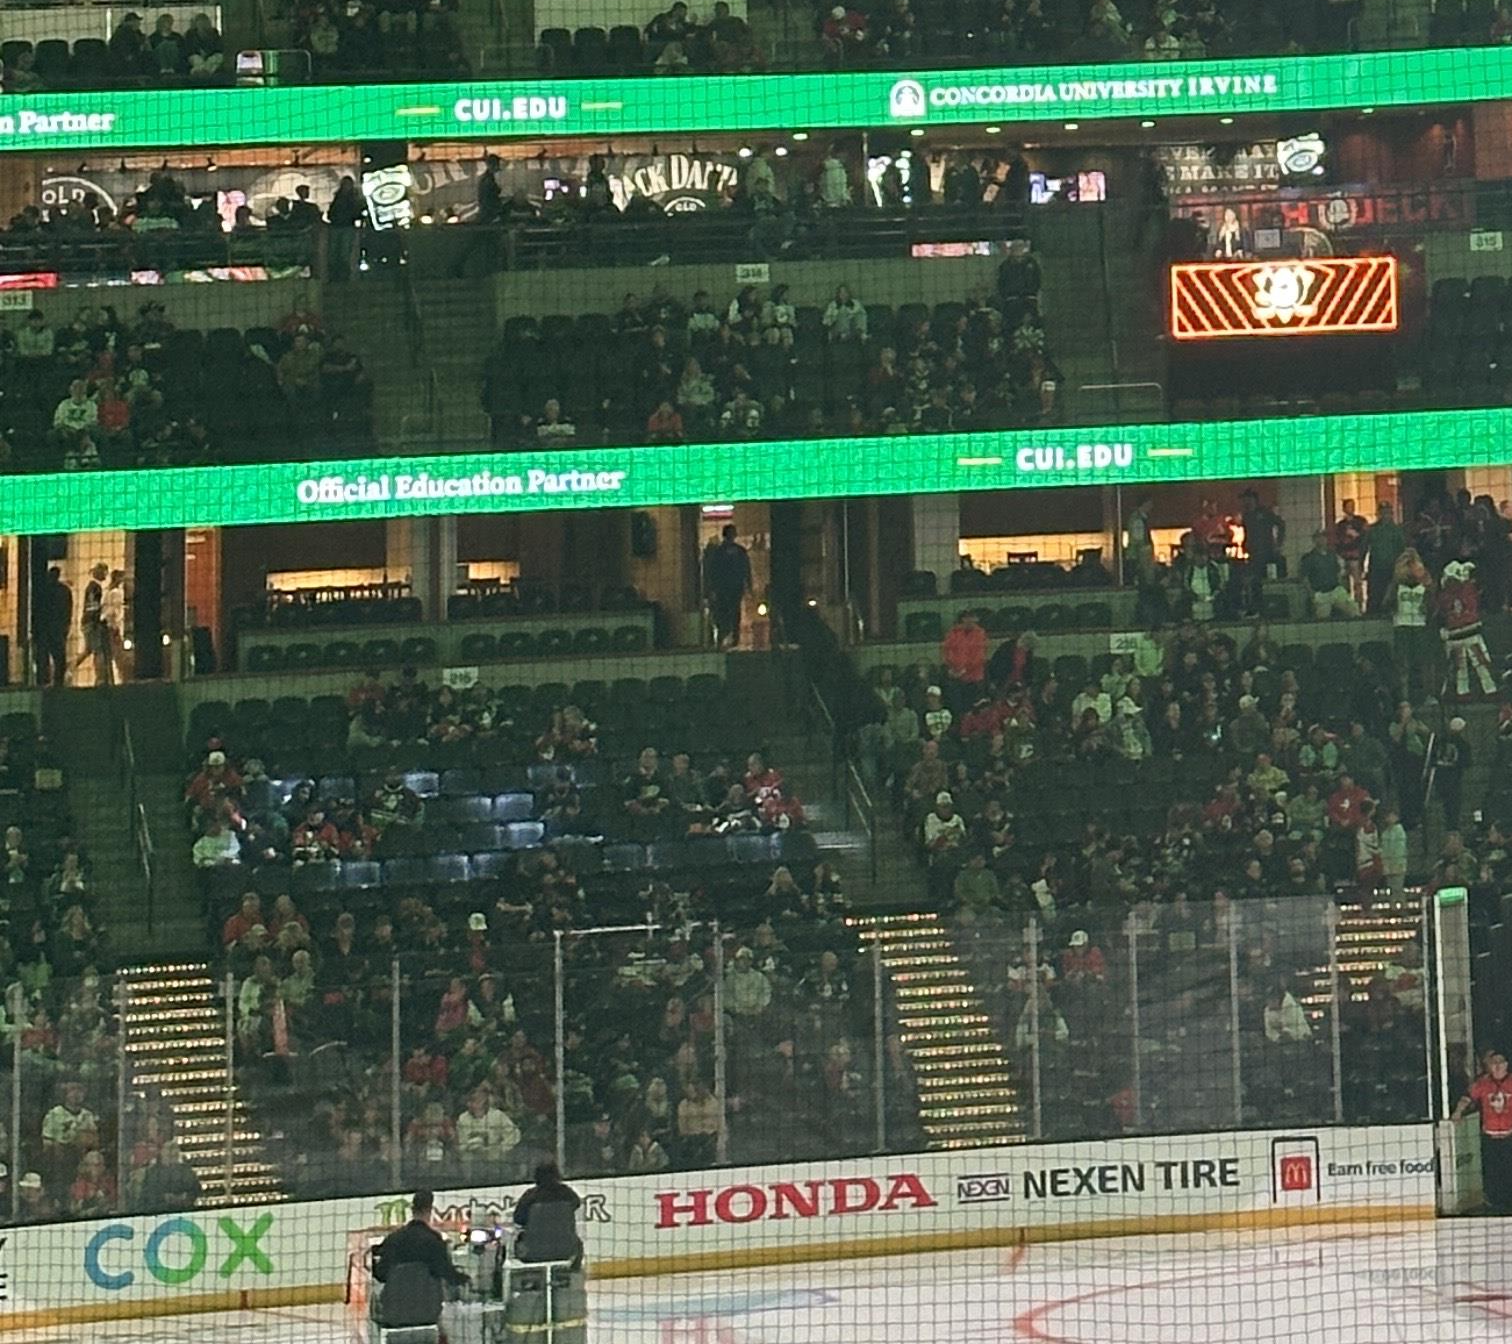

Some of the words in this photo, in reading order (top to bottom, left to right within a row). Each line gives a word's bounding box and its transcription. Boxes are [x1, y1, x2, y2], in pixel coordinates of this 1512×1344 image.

[930, 82, 1057, 107] CONCORDIA
[1058, 78, 1182, 101] UNIVERSITY
[1188, 74, 1278, 97] IRVINE
[20, 109, 115, 135] Partner
[454, 95, 568, 122] CUI.EDU
[1016, 444, 1134, 472] CUI.EDU
[297, 475, 390, 505] Official
[394, 471, 524, 501] Education
[526, 467, 624, 494] Partner
[1024, 1164, 1146, 1200] NEXEN
[1154, 1158, 1240, 1190] TIRE
[1327, 1162, 1364, 1177] Earn
[1366, 1161, 1397, 1176] free
[654, 1174, 938, 1229] HONDA
[957, 1177, 1010, 1200] NEXEN
[84, 1212, 274, 1290] COX
